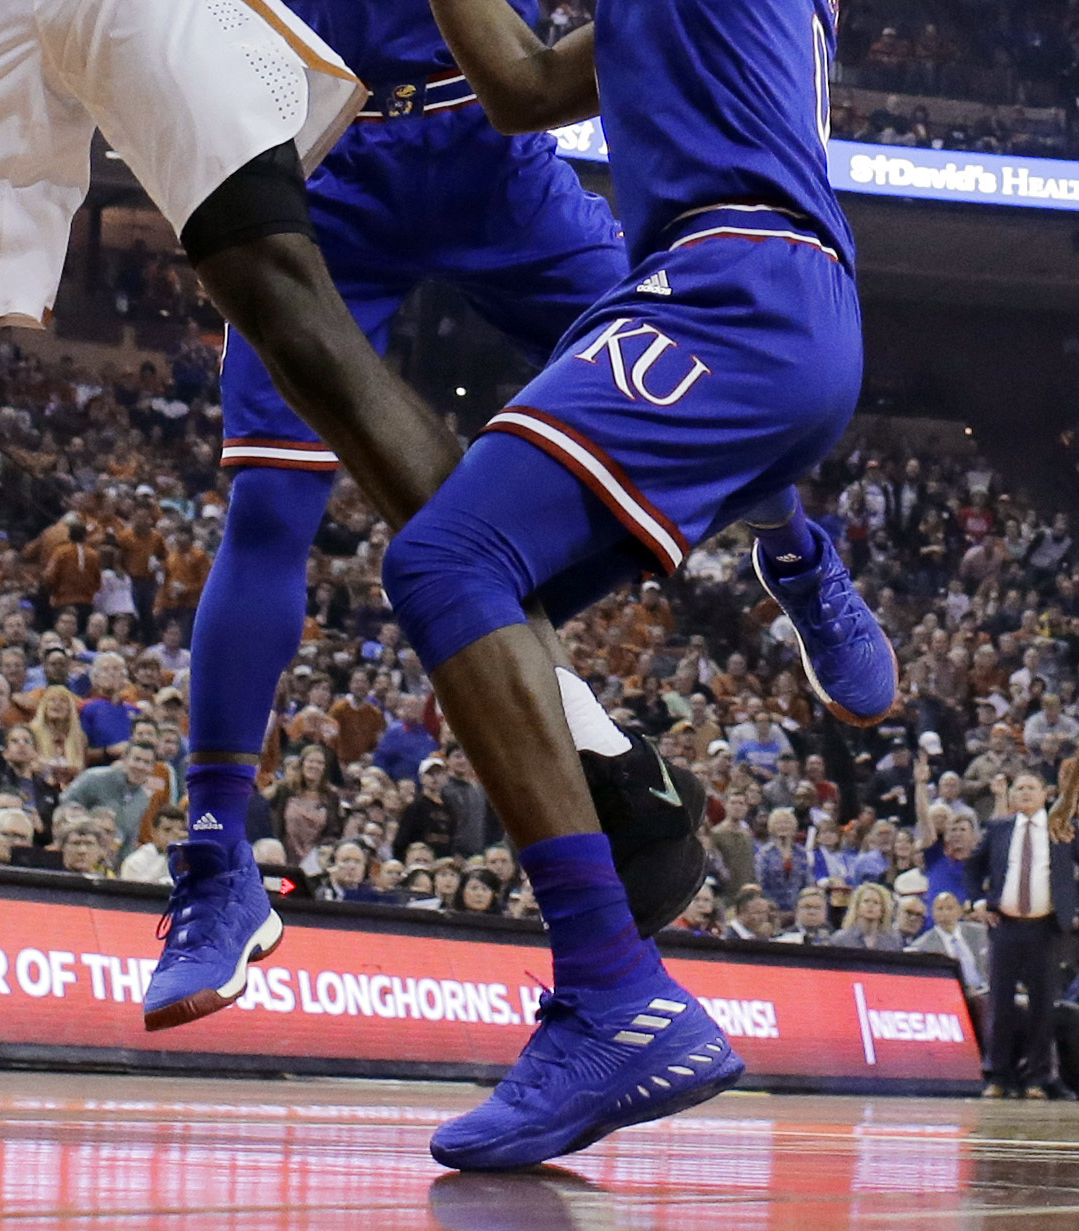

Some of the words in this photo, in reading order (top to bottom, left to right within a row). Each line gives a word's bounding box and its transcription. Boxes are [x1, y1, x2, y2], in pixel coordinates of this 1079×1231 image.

[574, 318, 712, 407] KU
[16, 948, 78, 998] OF
[297, 970, 522, 1025] LONGHORNS.
[867, 1008, 965, 1043] NISSAN
